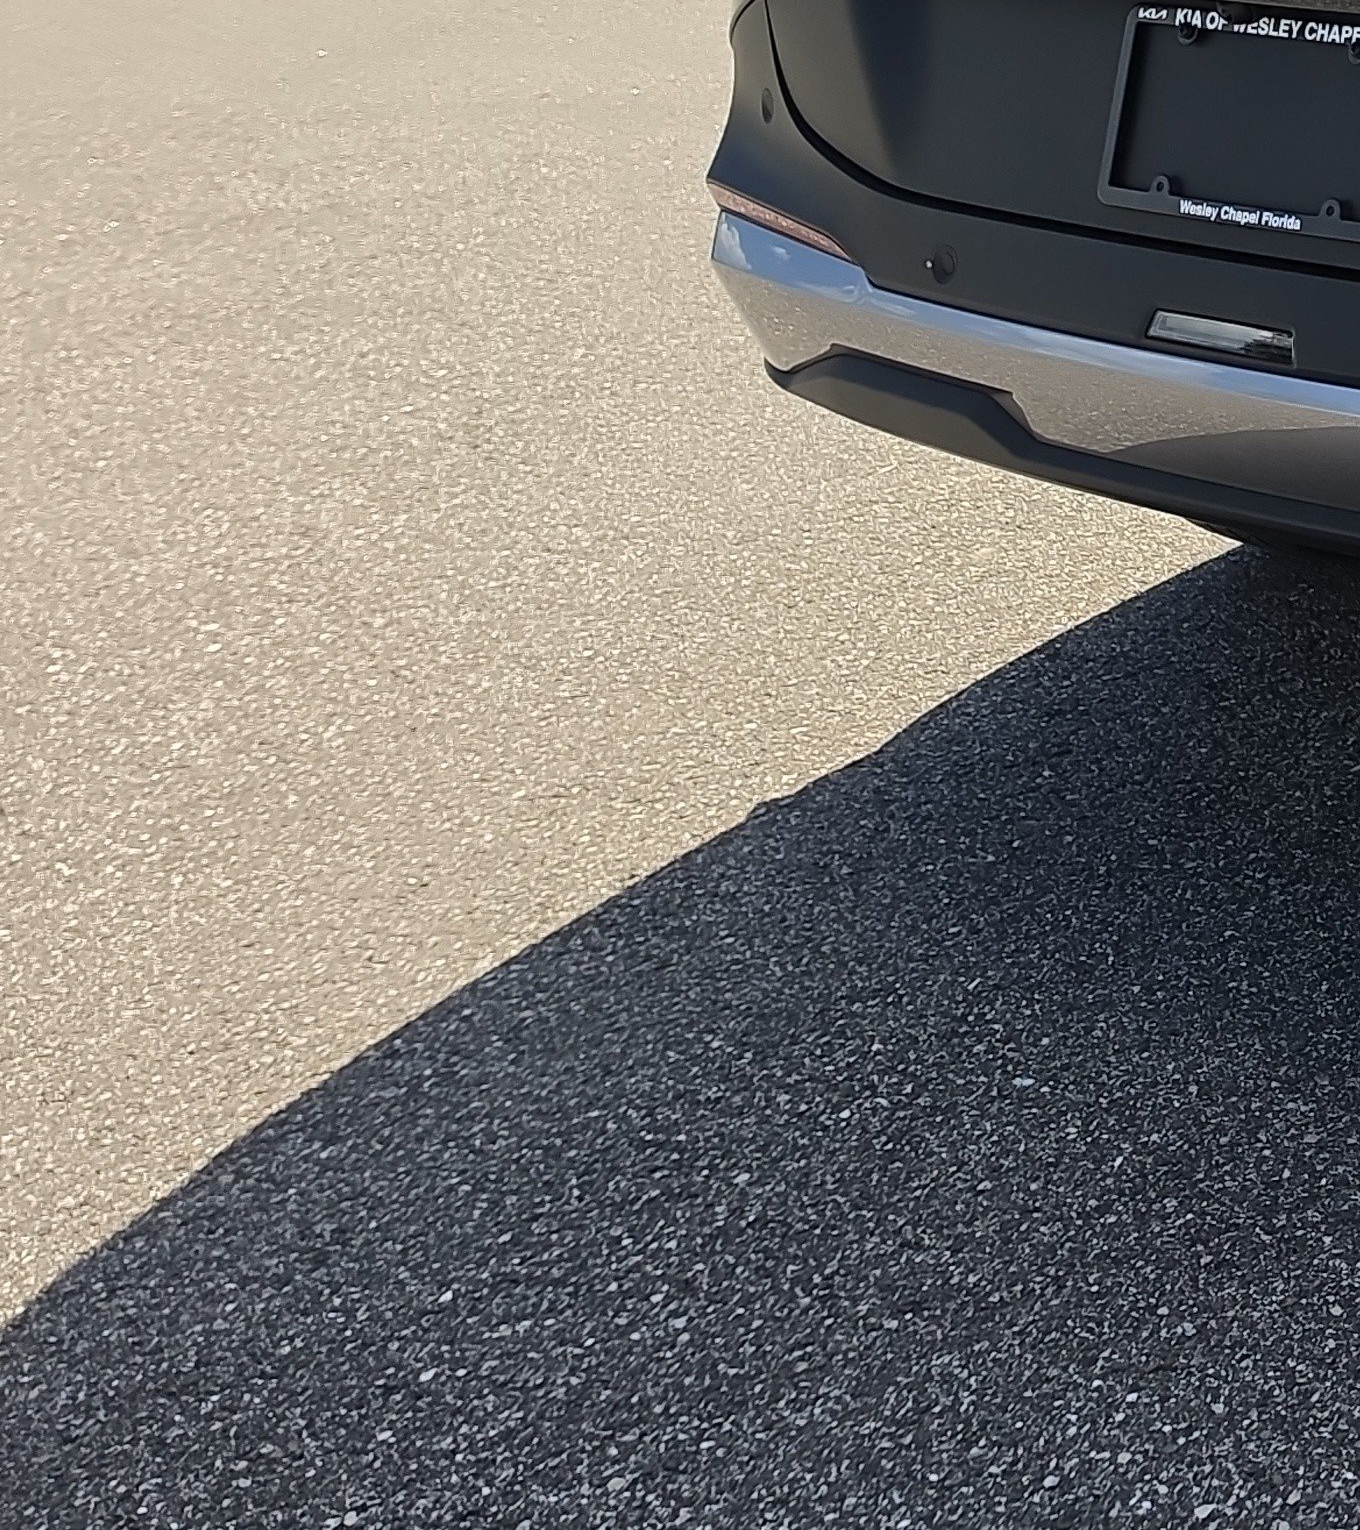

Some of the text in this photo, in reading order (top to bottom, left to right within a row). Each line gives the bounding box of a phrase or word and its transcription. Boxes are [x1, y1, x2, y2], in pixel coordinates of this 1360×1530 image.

[1175, 7, 1202, 29] KIA
[1179, 199, 1301, 231] Wesley Chapel Florida
